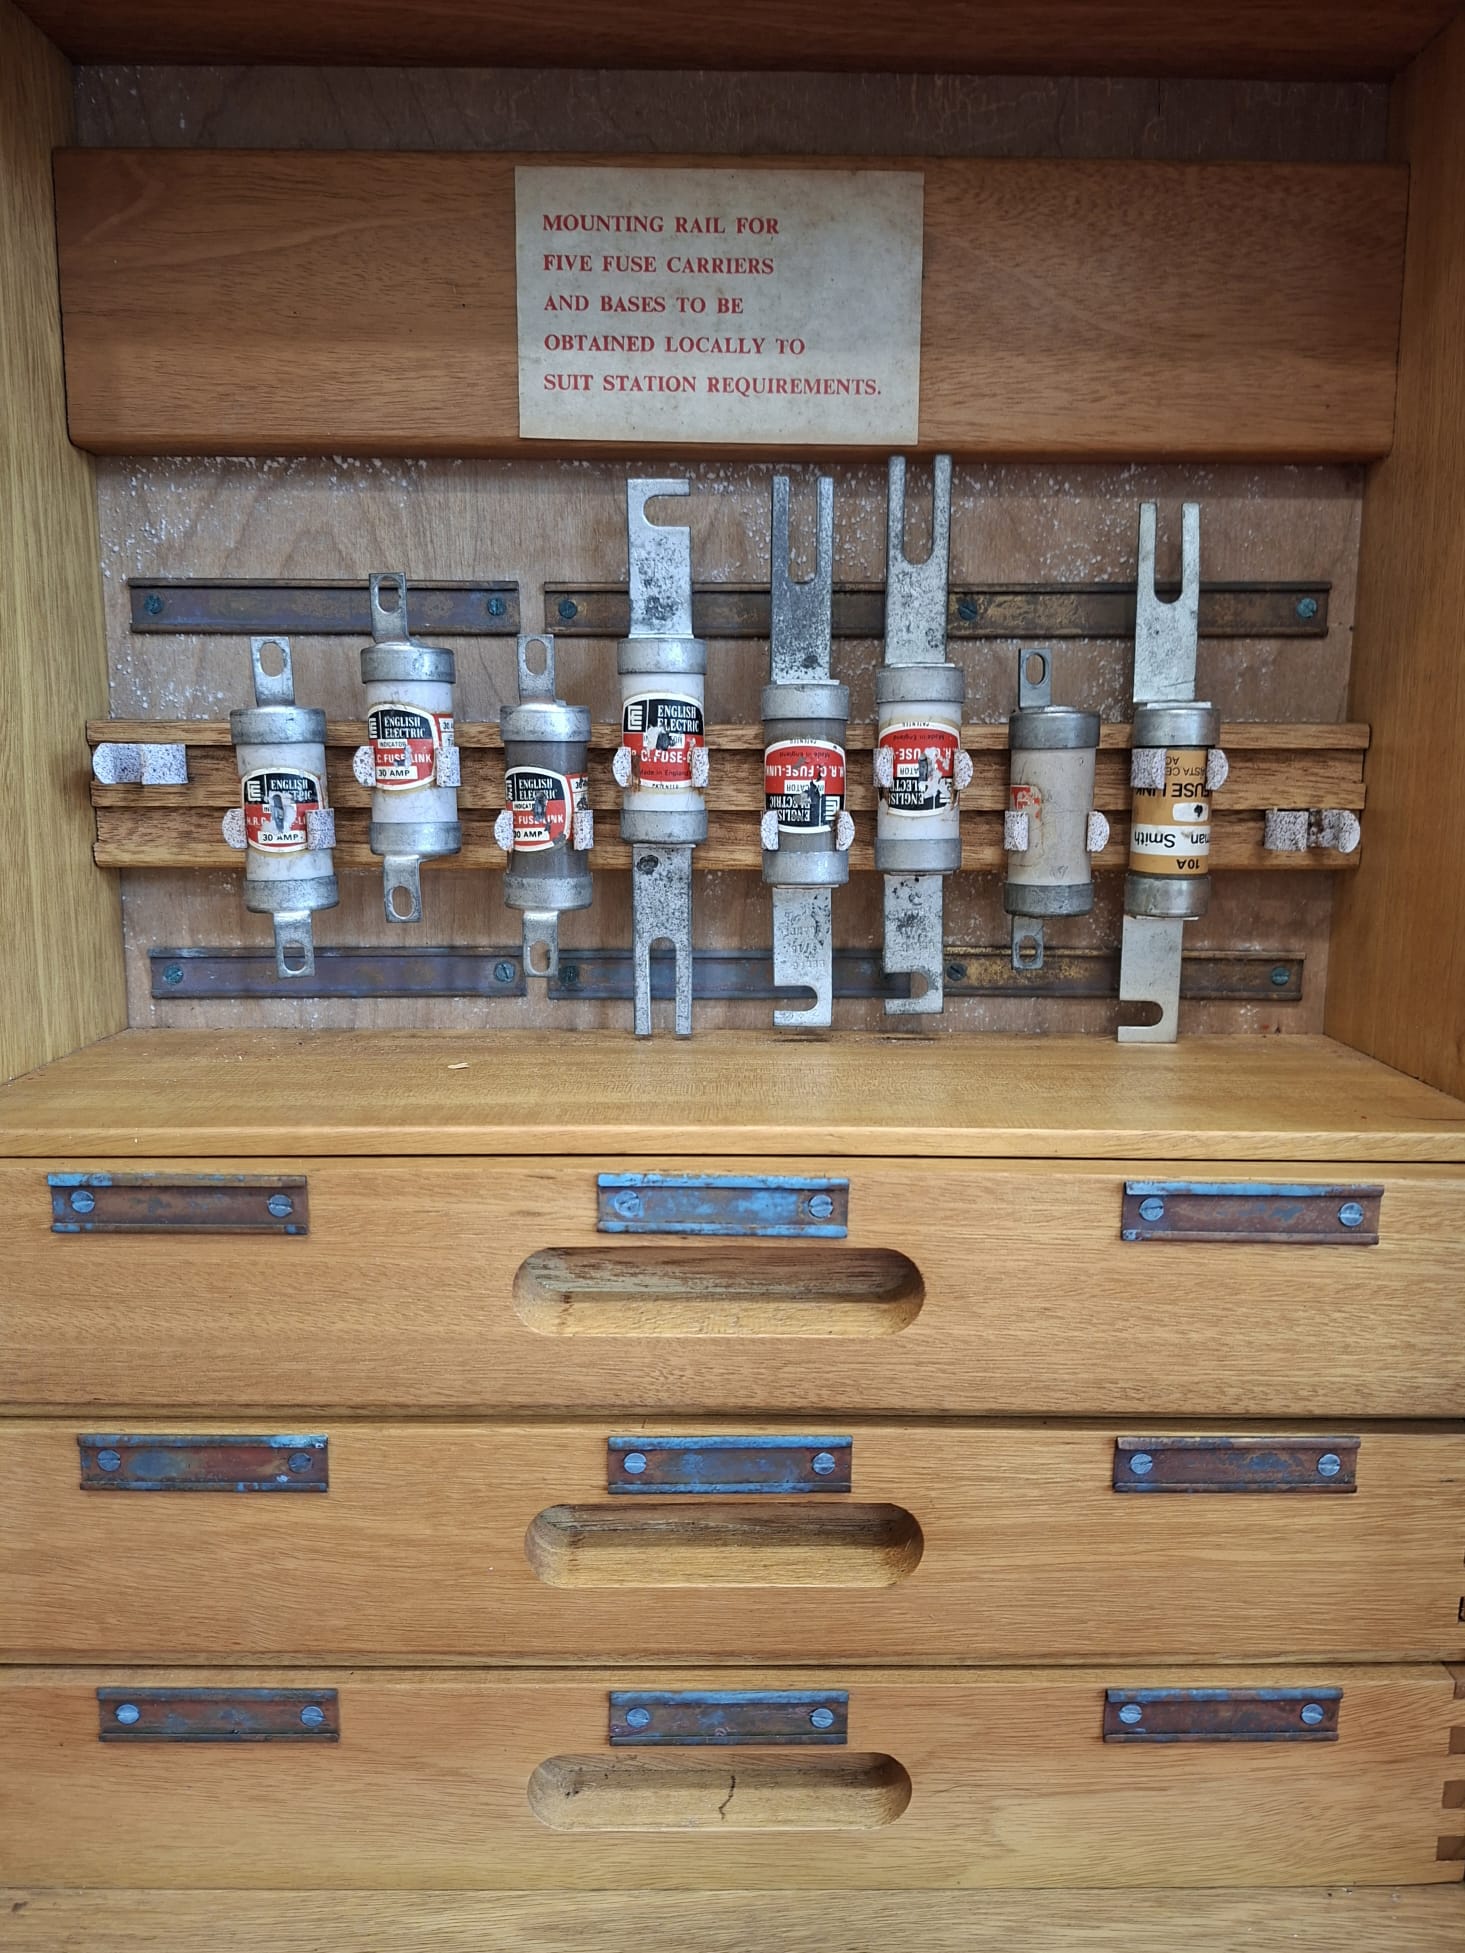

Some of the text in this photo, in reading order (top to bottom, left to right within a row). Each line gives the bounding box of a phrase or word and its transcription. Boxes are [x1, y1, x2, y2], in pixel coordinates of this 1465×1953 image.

[543, 214, 780, 235] MOUNTING RAIL FOR
[543, 254, 774, 275] FIVE FUSE CARRIERS
[544, 295, 744, 314] AND BASES TO BE
[543, 334, 805, 355] OBTAINED LOCALLY TO
[543, 374, 881, 397] SUIT STATION REQUIREMENTS.
[657, 704, 697, 719] ENGLISH
[384, 716, 421, 728] ENGLISH
[657, 718, 700, 732] ELECTRIC
[385, 727, 426, 739] ELECTRIC
[378, 769, 410, 777] 30 AMP
[270, 779, 308, 790] ENGLISH
[518, 778, 553, 789] ENGLISH
[776, 809, 811, 822] ENGLIS
[262, 833, 299, 842] 30 AMP
[523, 830, 543, 838] AMP
[1134, 831, 1176, 849] Smith
